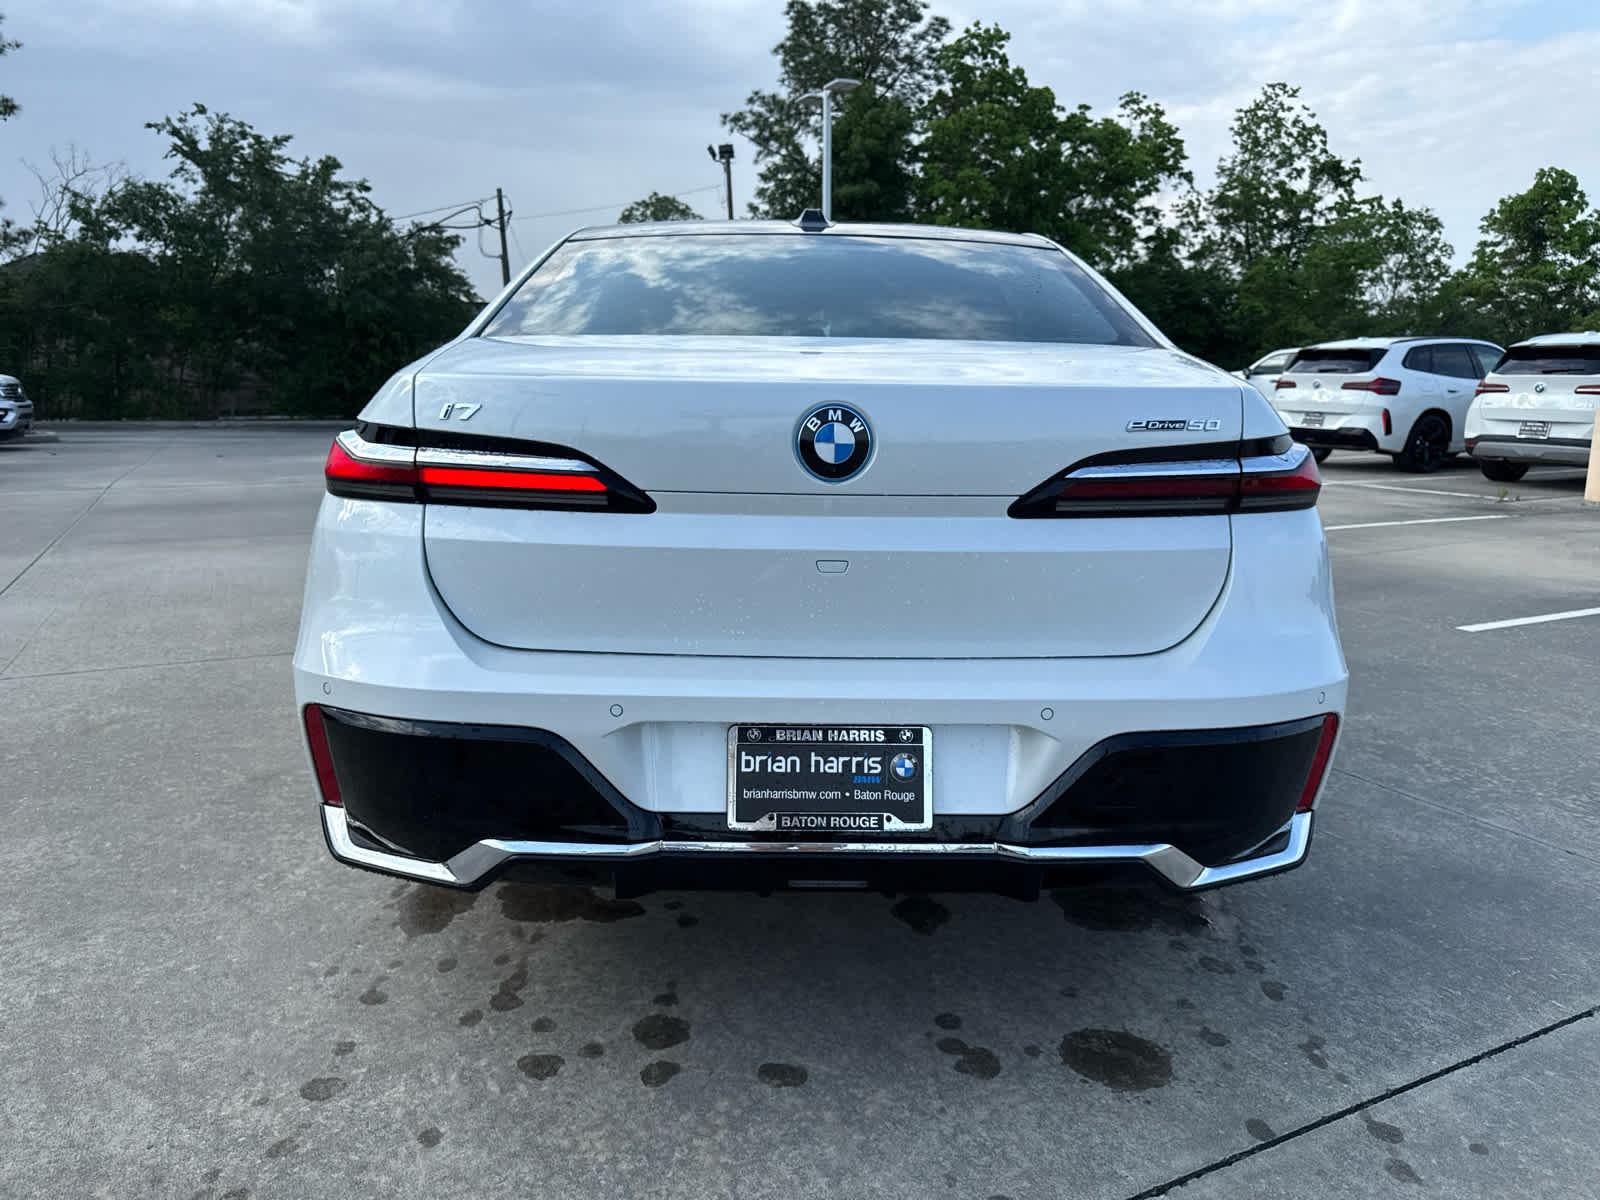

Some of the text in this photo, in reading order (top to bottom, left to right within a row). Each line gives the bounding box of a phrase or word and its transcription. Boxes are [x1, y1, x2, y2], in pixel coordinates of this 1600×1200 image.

[439, 403, 483, 421] i7
[806, 409, 865, 433] BMW
[775, 729, 886, 742] BRIAN HARRIS
[740, 750, 801, 774] brian
[810, 751, 882, 774] harris
[852, 775, 882, 785] BMW
[743, 789, 915, 803] brianharrisbmw.com Baton Rouge
[781, 815, 879, 828] BATON ROUGE
